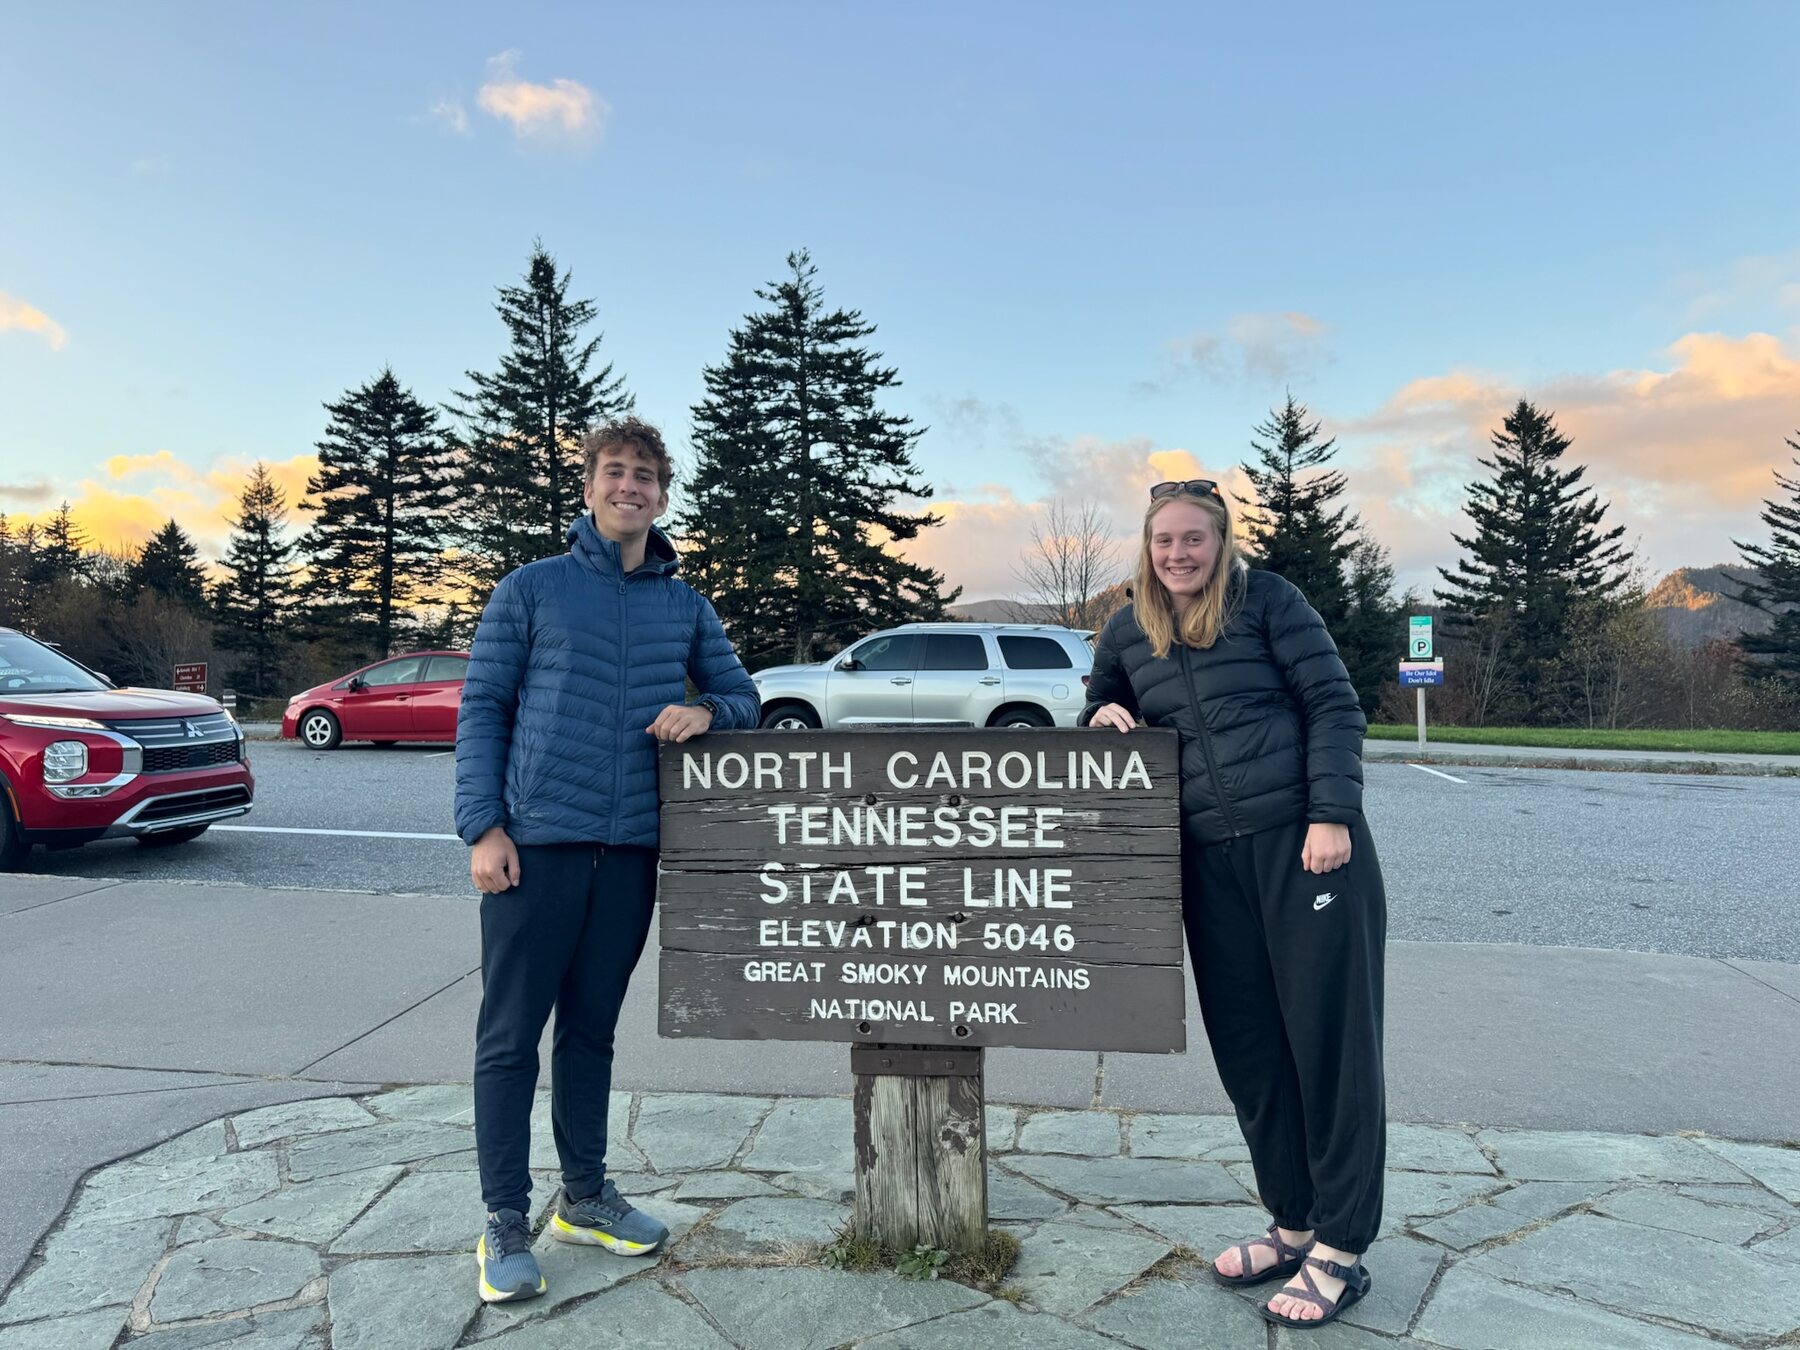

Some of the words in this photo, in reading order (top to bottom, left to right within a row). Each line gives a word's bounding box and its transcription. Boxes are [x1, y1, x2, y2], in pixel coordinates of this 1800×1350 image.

[1417, 641, 1426, 652] P
[683, 752, 852, 789] NORTH
[886, 751, 1152, 790] CAROLINA
[768, 806, 1064, 848] TENNESSEE
[759, 862, 928, 906] STATE
[963, 868, 1073, 909] LINE
[759, 920, 956, 949] ELEVATION
[983, 925, 1075, 951] 5046
[744, 963, 826, 983] GREAT
[841, 964, 927, 985] SMOKY
[944, 966, 1090, 989] MOUNTAINS
[810, 999, 934, 1022] NATIONAL
[950, 1003, 1018, 1024] PARK
